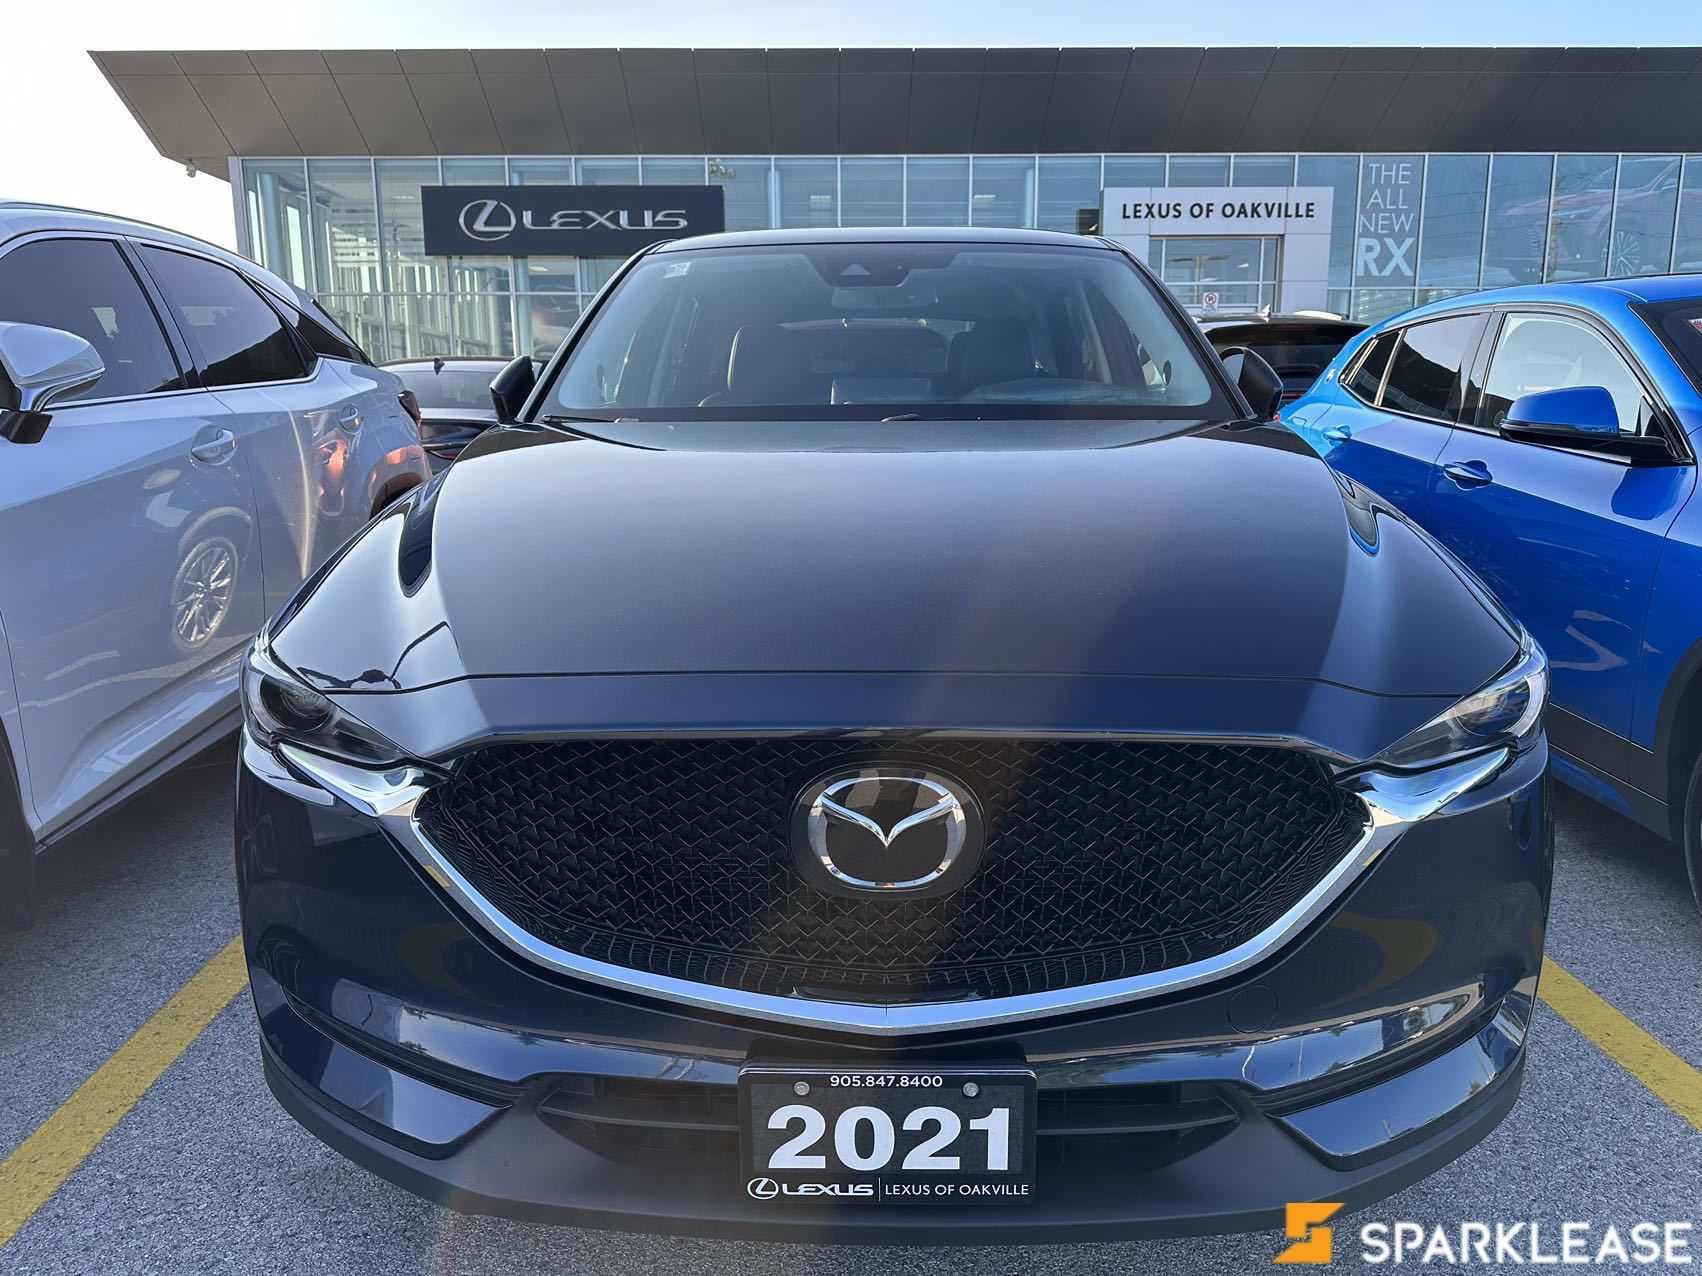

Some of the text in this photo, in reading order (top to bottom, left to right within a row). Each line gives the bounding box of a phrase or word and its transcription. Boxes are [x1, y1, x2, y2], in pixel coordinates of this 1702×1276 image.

[1369, 164, 1411, 184] THE
[1367, 189, 1408, 209] ALL
[522, 209, 688, 230] LEXUS
[1122, 202, 1315, 219] LEXUS OF OAKVILLE
[1359, 213, 1413, 233] NEW
[1357, 238, 1415, 277] RX
[830, 1075, 943, 1088] 905.847.8400
[767, 1104, 1010, 1171] 2021
[782, 1183, 874, 1195] LEXUS
[885, 1184, 1029, 1195] LEXUS OF OAKVILLE
